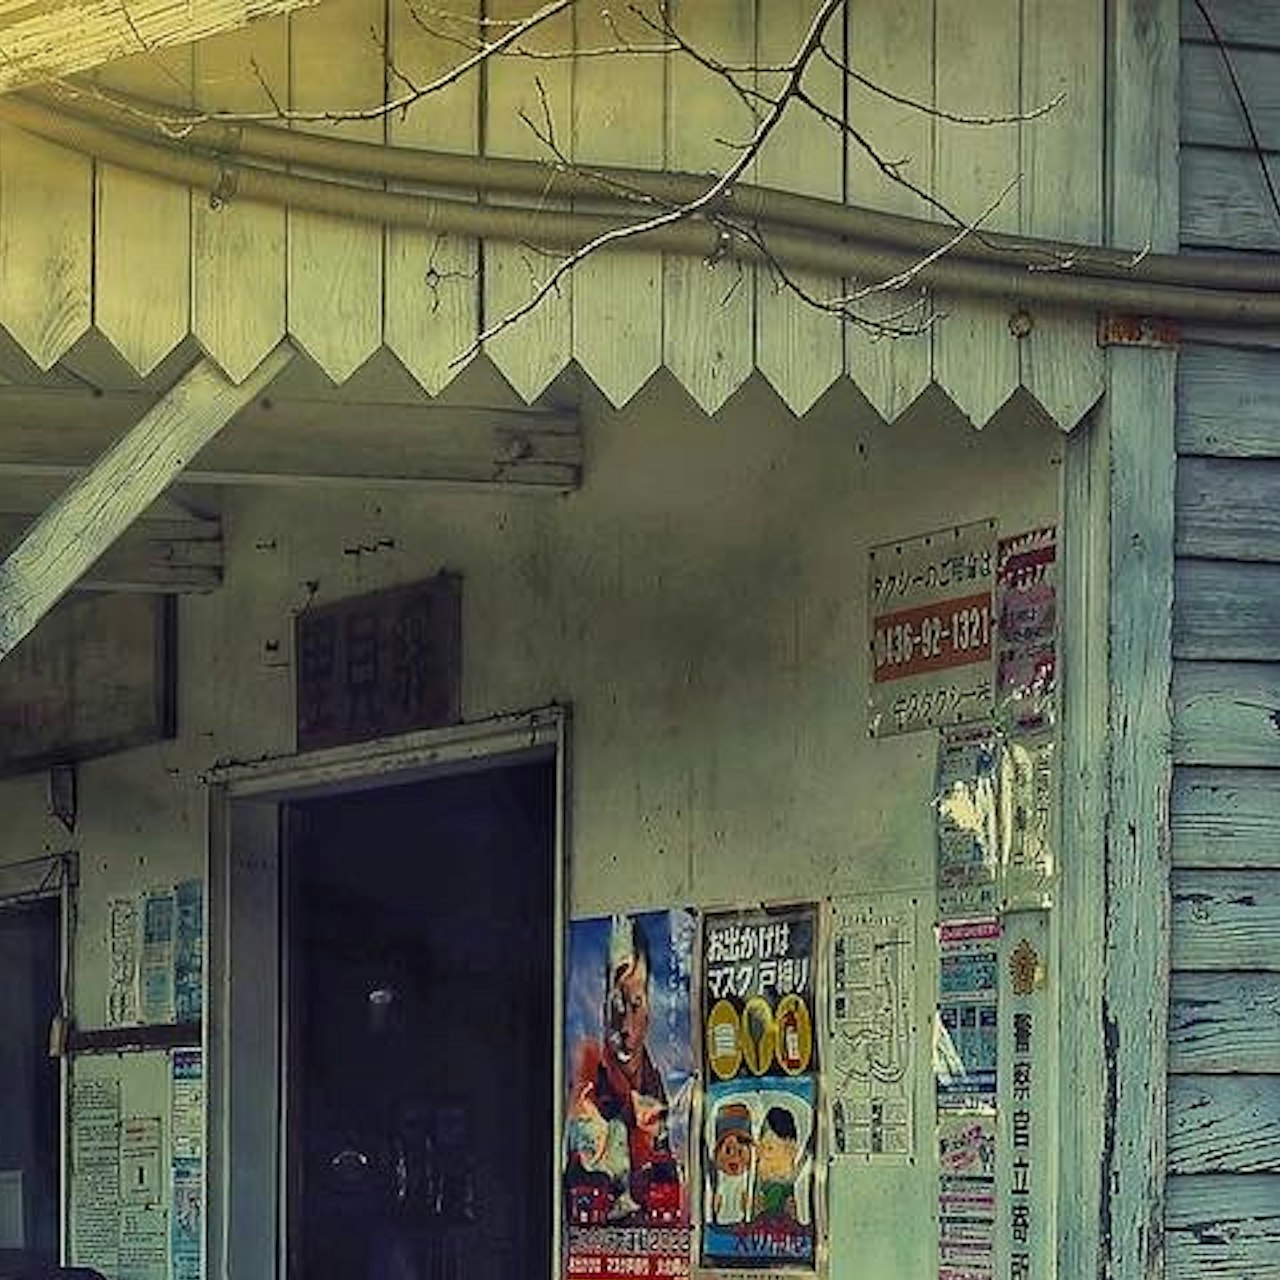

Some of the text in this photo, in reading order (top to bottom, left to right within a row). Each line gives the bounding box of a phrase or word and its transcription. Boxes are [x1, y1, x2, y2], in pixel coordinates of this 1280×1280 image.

[707, 922, 790, 962] お出かけは
[708, 965, 754, 999] マスク
